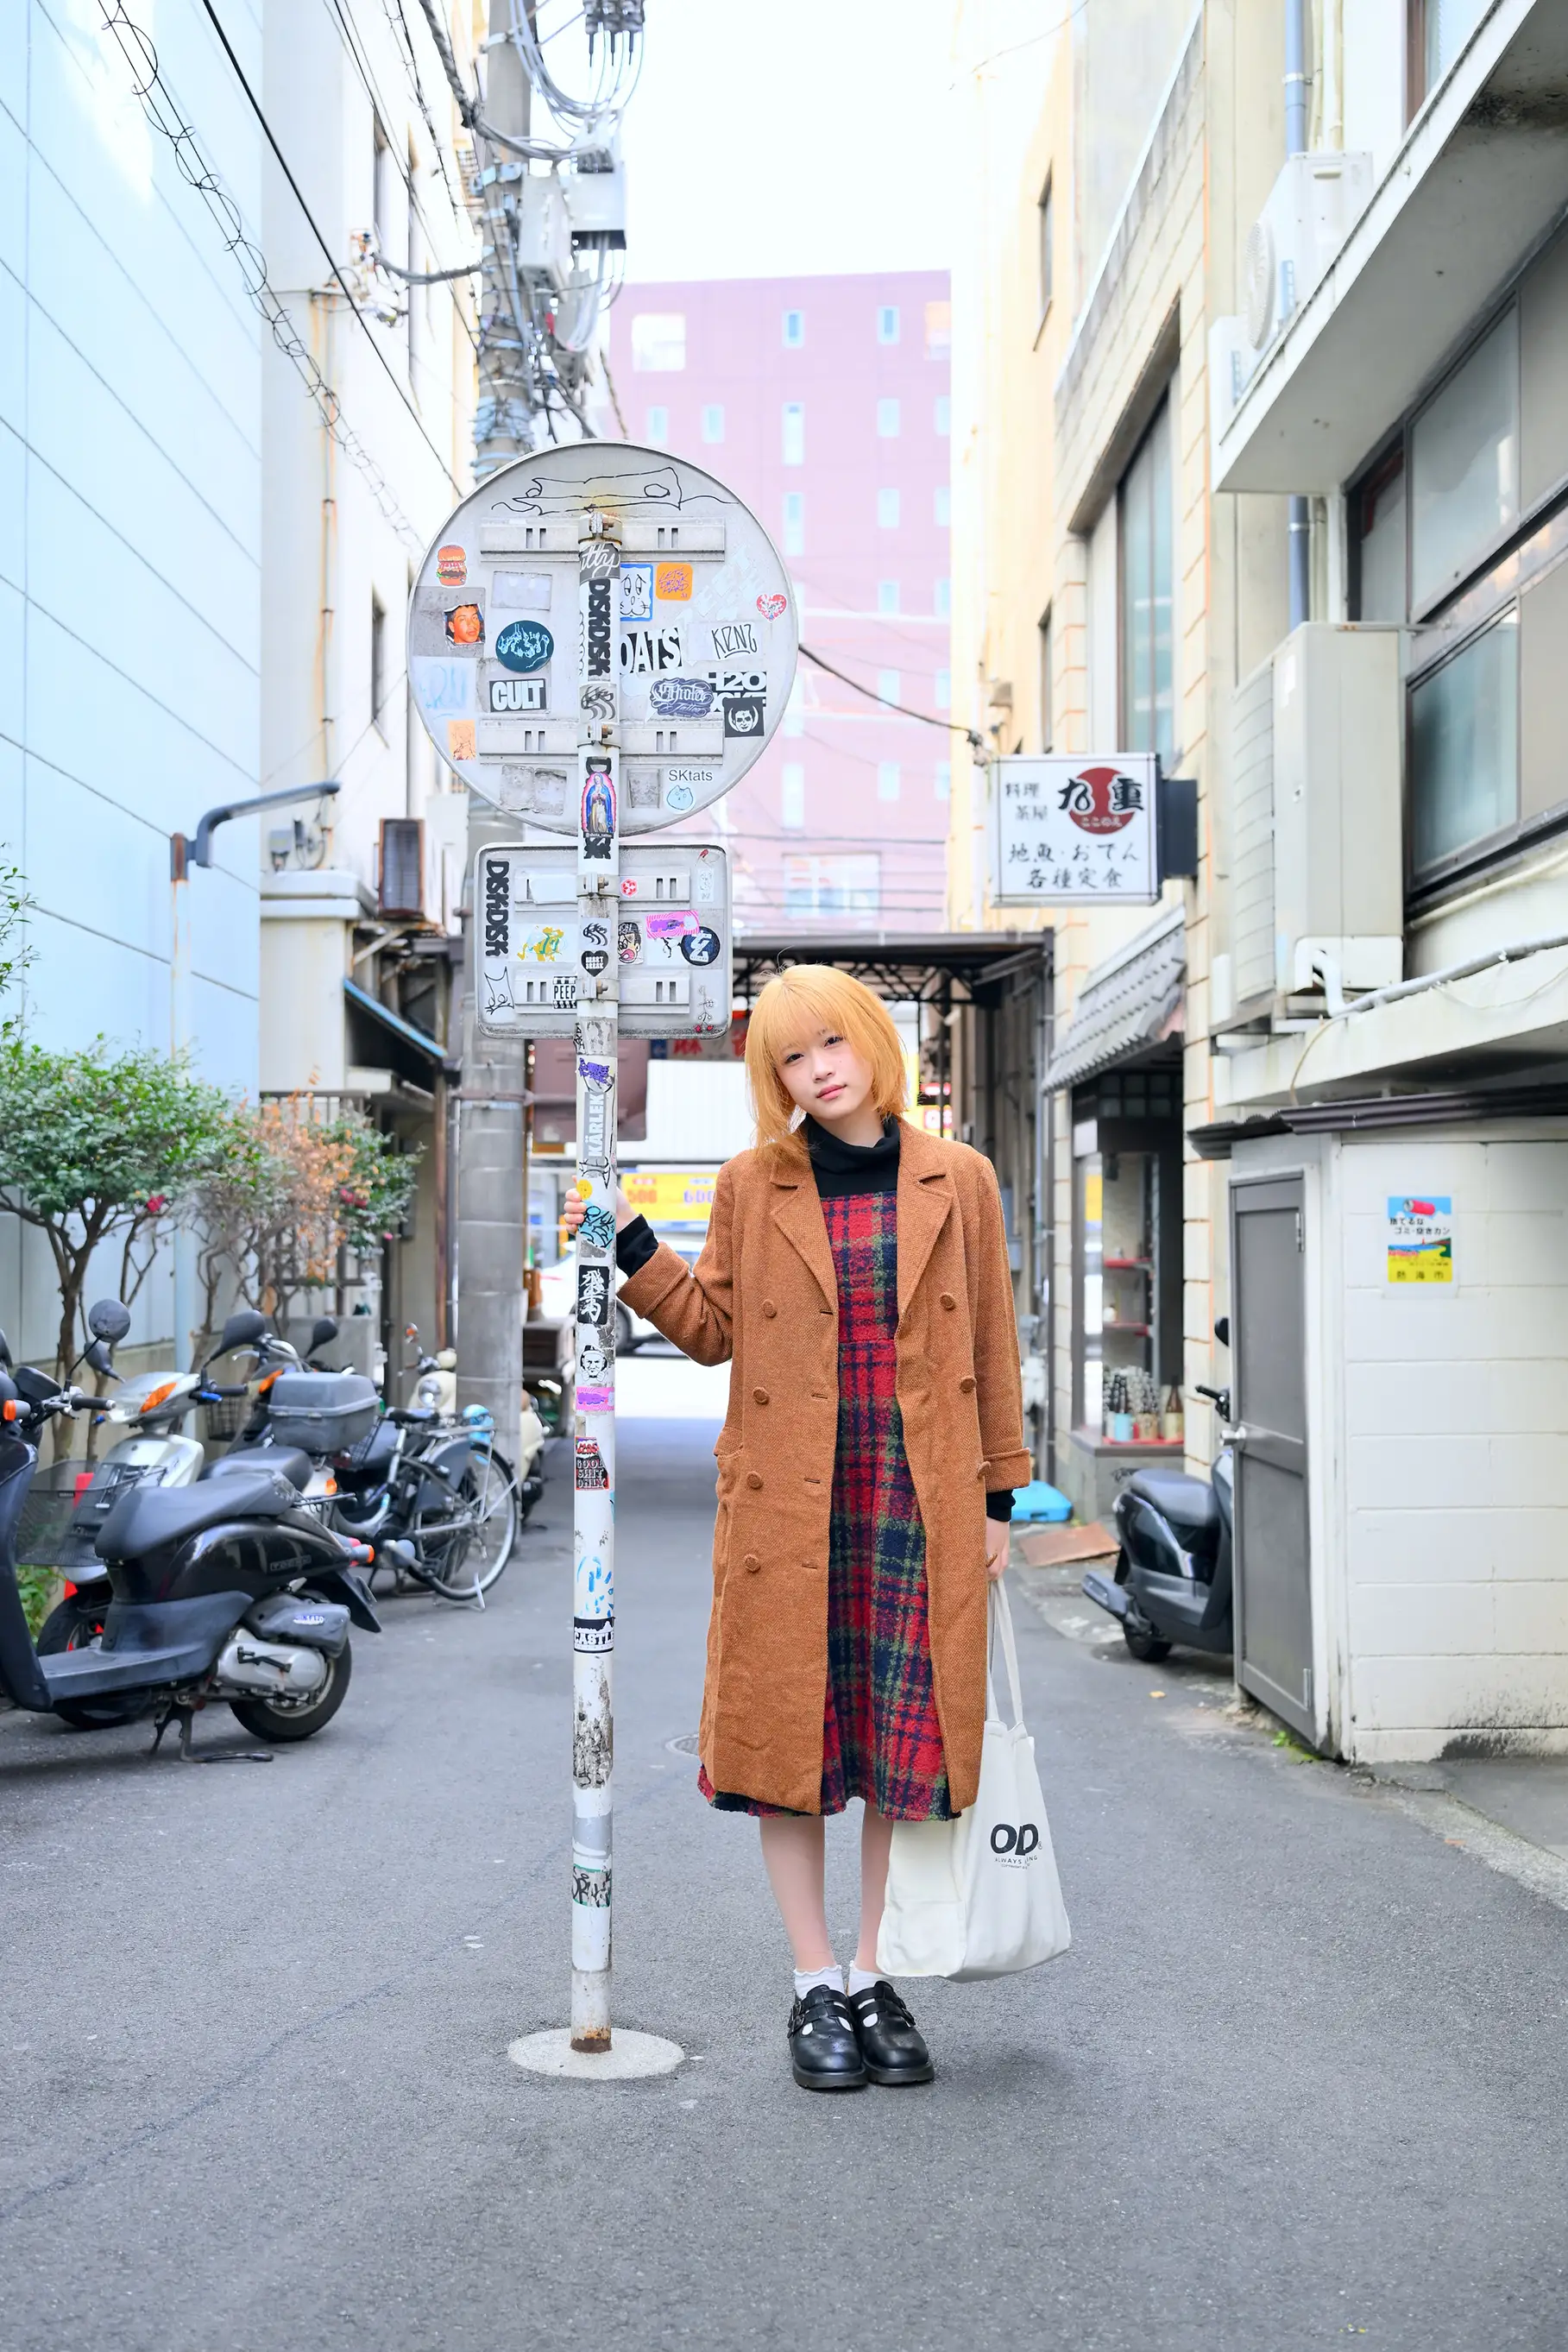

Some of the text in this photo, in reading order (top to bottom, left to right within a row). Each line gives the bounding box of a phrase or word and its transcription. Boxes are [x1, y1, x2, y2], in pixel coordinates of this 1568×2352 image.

[492, 680, 544, 710] CULT
[669, 769, 713, 781] SKtats
[1005, 782, 1040, 798] 料理
[1016, 805, 1048, 821] 茶屋
[1026, 867, 1123, 890] 各種定食
[554, 985, 576, 999] PEEP
[584, 1094, 604, 1157] KÄRLEK
[990, 1823, 1039, 1856] OD
